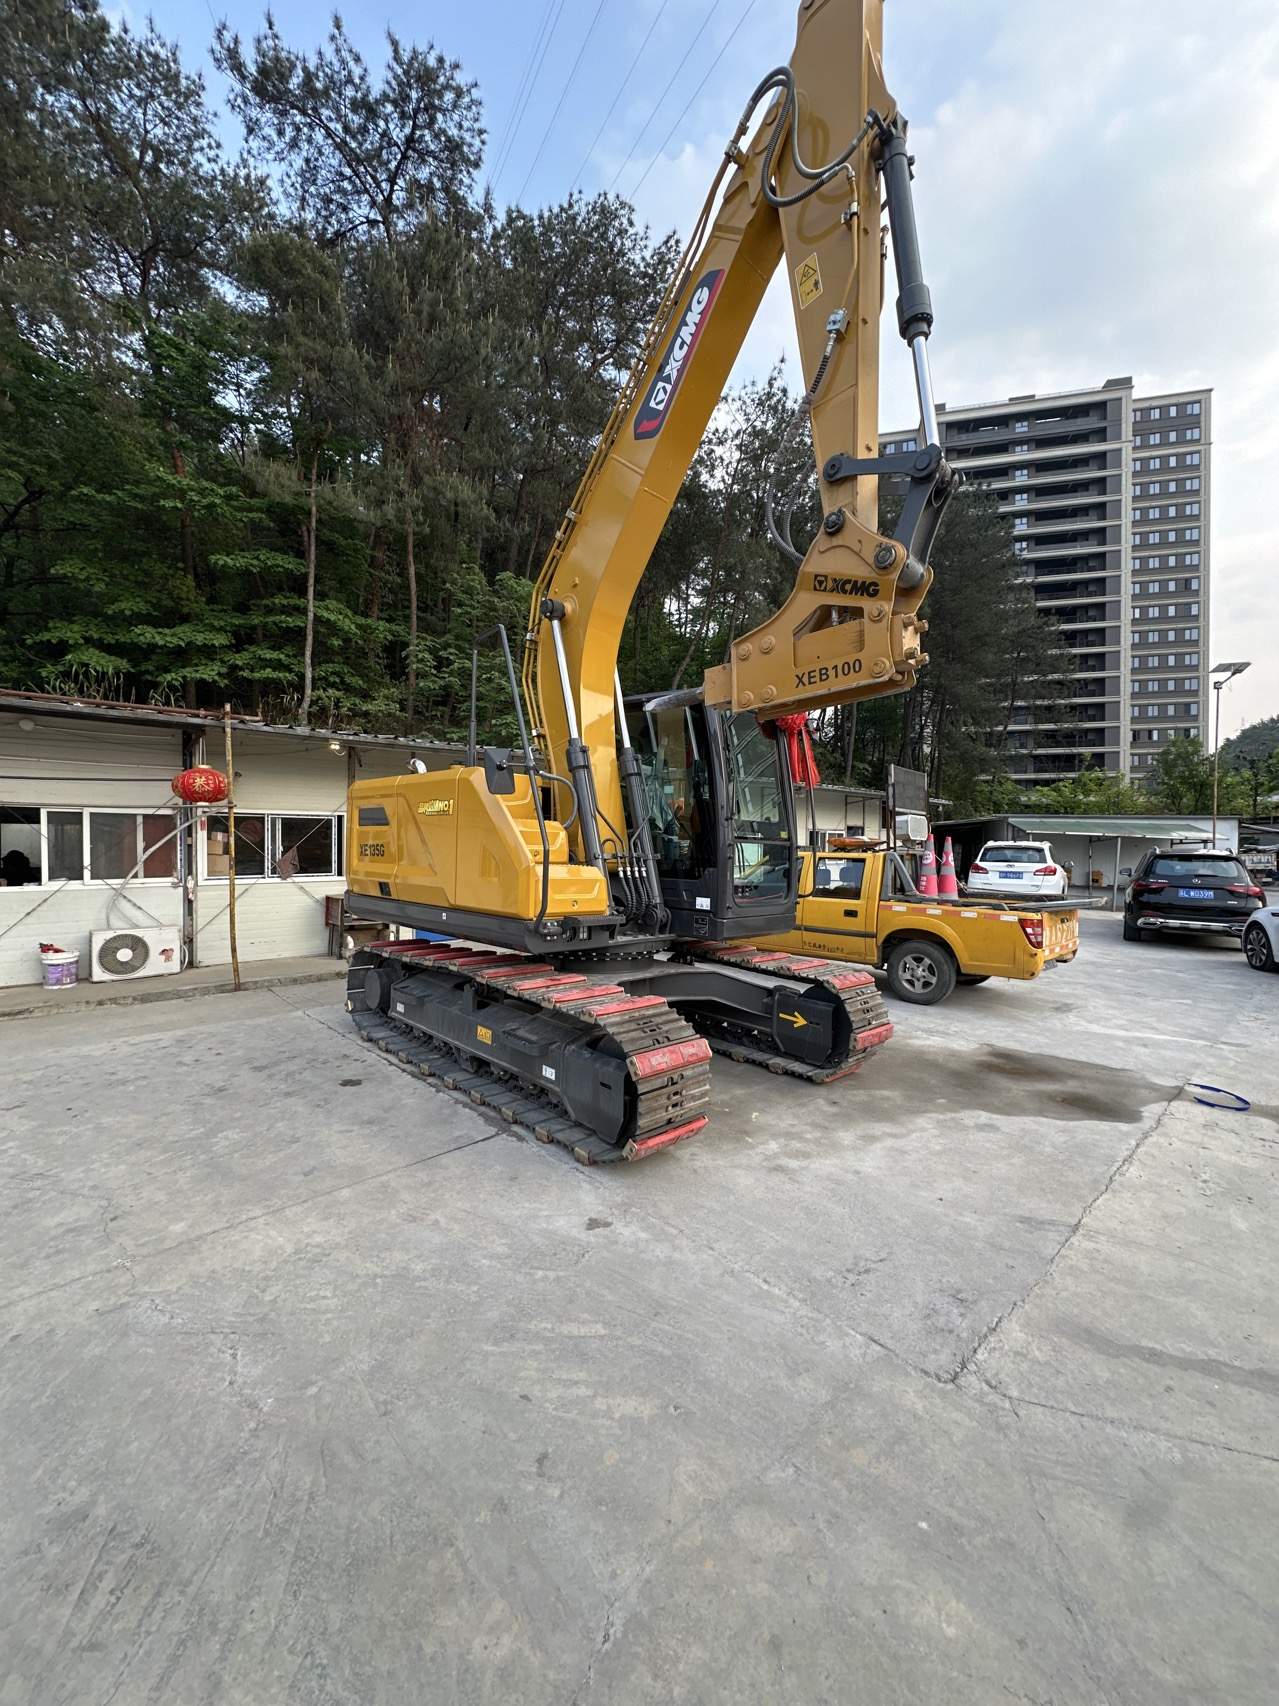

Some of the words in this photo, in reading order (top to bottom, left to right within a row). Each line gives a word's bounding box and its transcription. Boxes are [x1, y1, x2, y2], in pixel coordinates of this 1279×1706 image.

[663, 286, 710, 385] XCMG
[827, 577, 880, 598] XCMG
[795, 658, 863, 688] XEB100
[359, 843, 385, 857] XE135G
